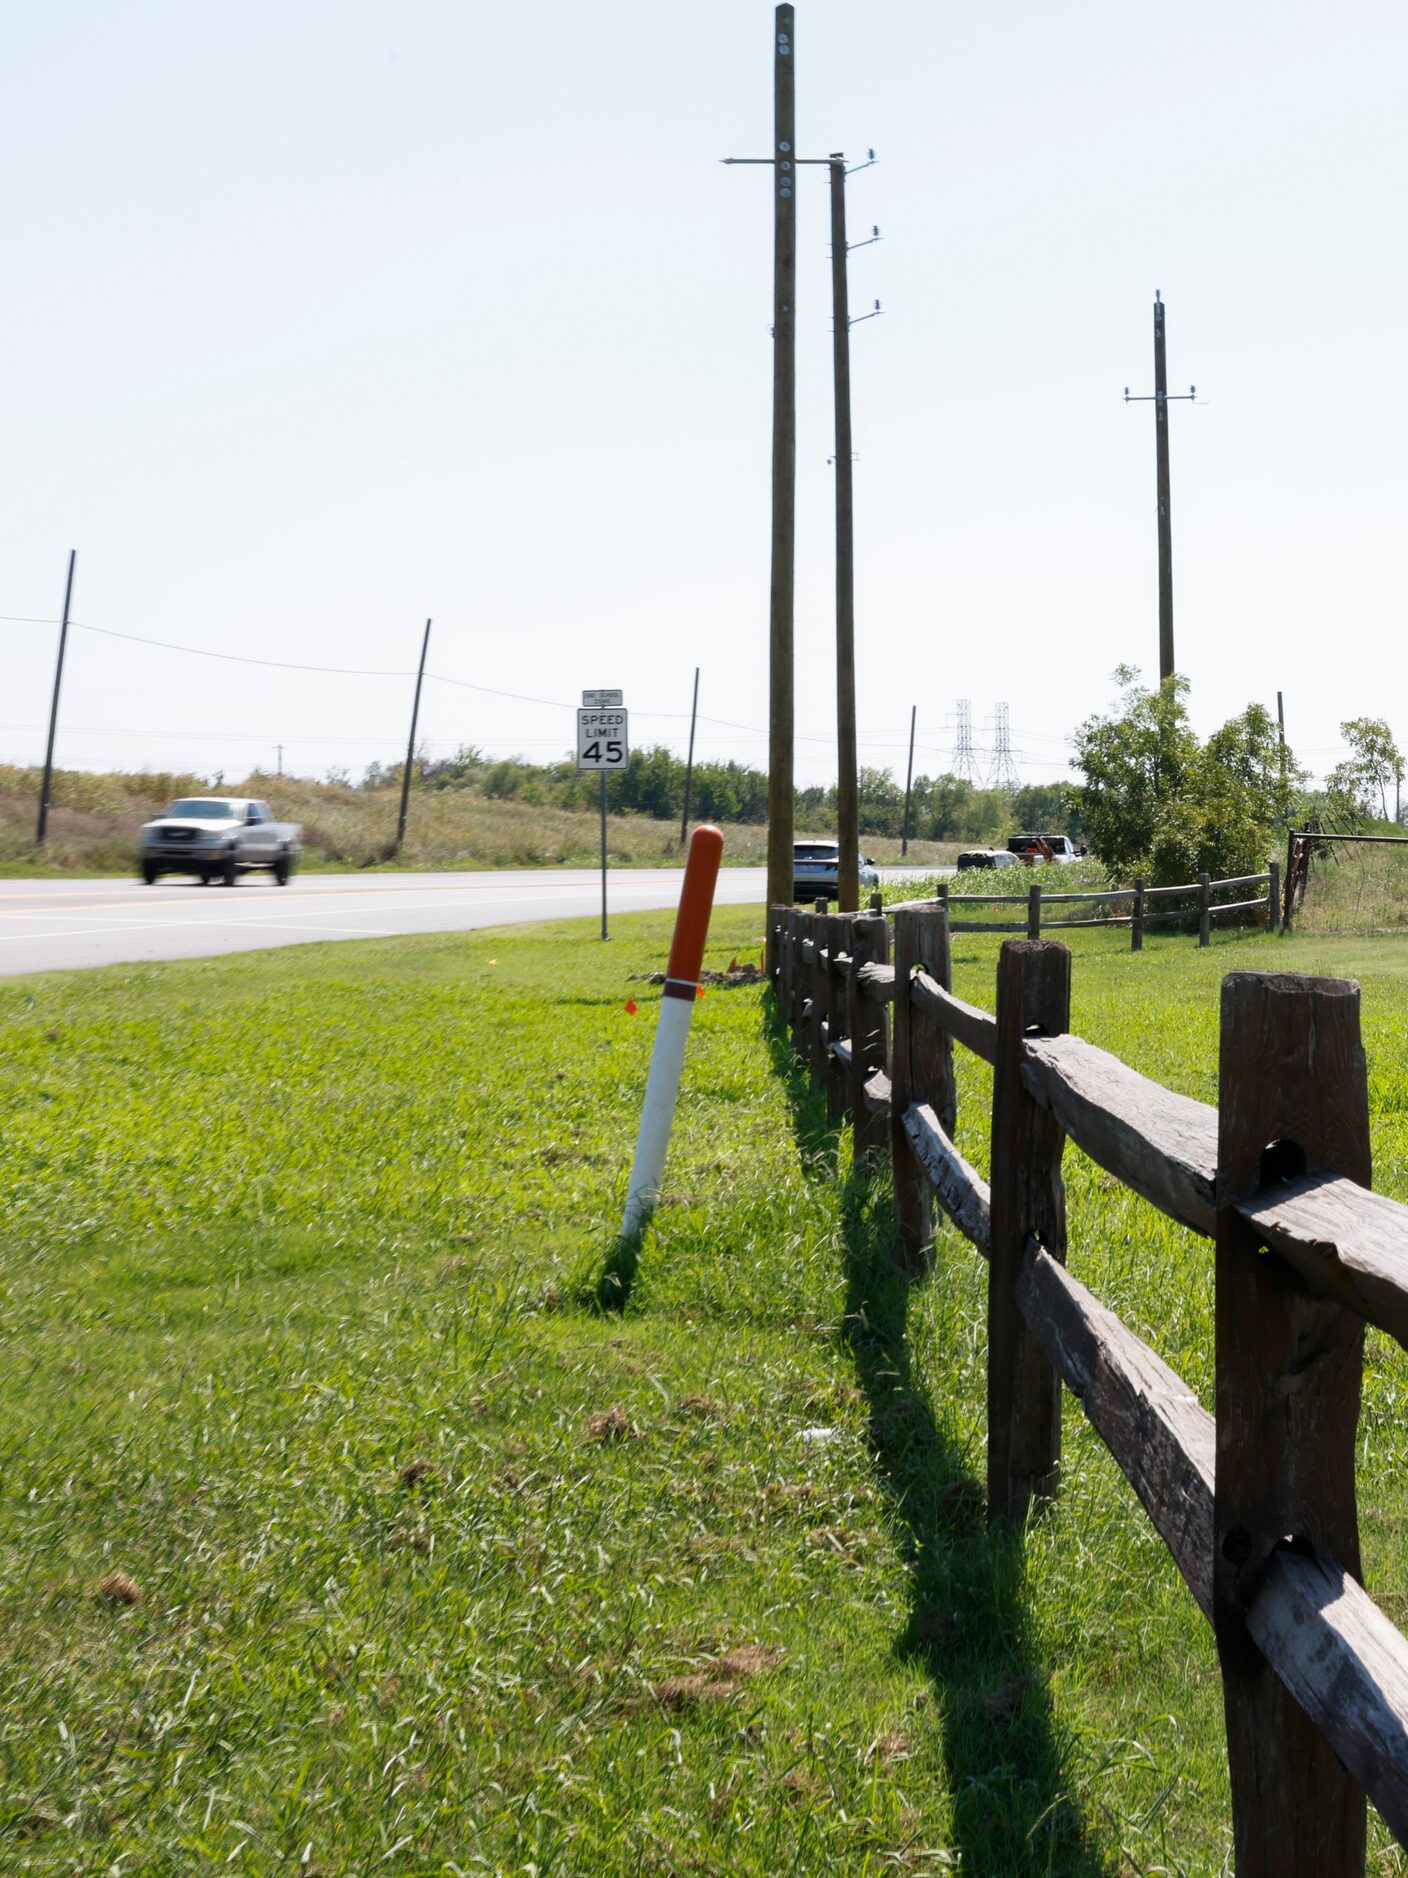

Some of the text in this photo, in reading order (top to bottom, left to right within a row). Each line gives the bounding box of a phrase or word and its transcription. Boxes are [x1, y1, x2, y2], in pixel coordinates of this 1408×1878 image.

[581, 715, 624, 725] SPEED
[585, 728, 619, 738] LIMIT
[582, 741, 623, 763] 45
